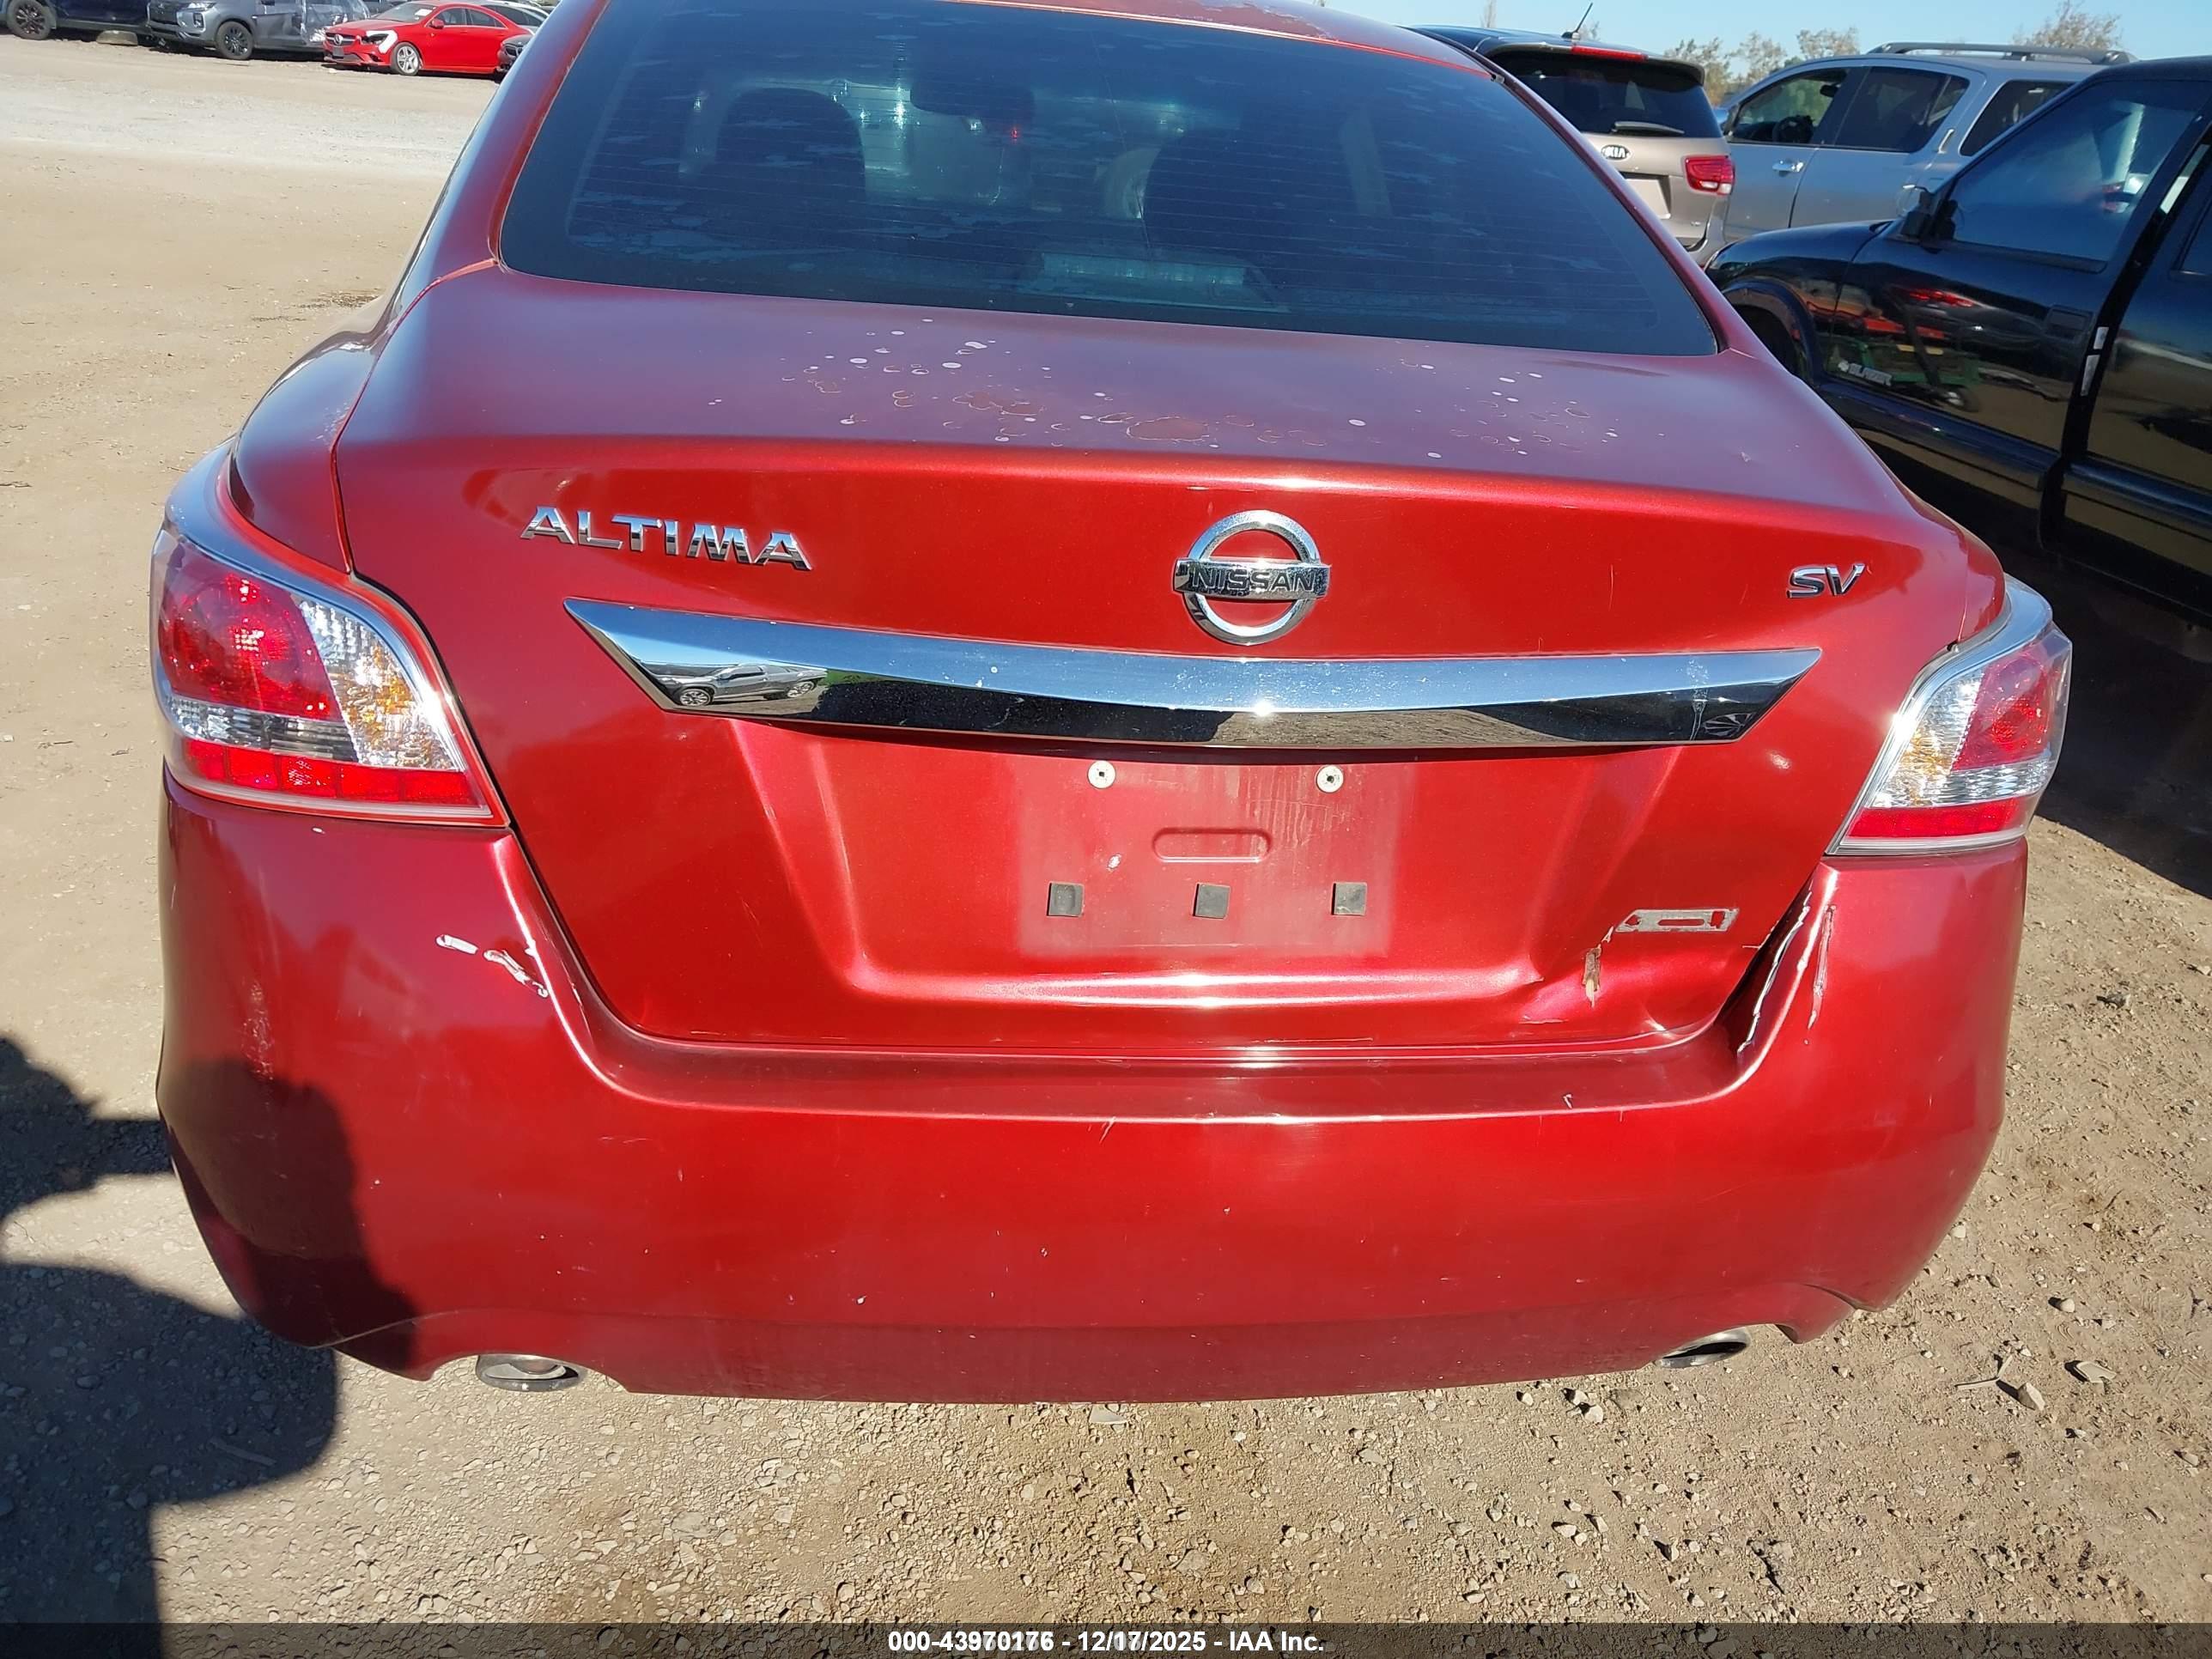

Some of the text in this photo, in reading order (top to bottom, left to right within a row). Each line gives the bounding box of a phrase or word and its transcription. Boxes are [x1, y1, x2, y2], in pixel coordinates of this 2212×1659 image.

[1603, 145, 1627, 159] KIA
[520, 506, 812, 571] ALTIMA
[1191, 563, 1316, 592] NISSAN
[1787, 563, 1865, 599] SV
